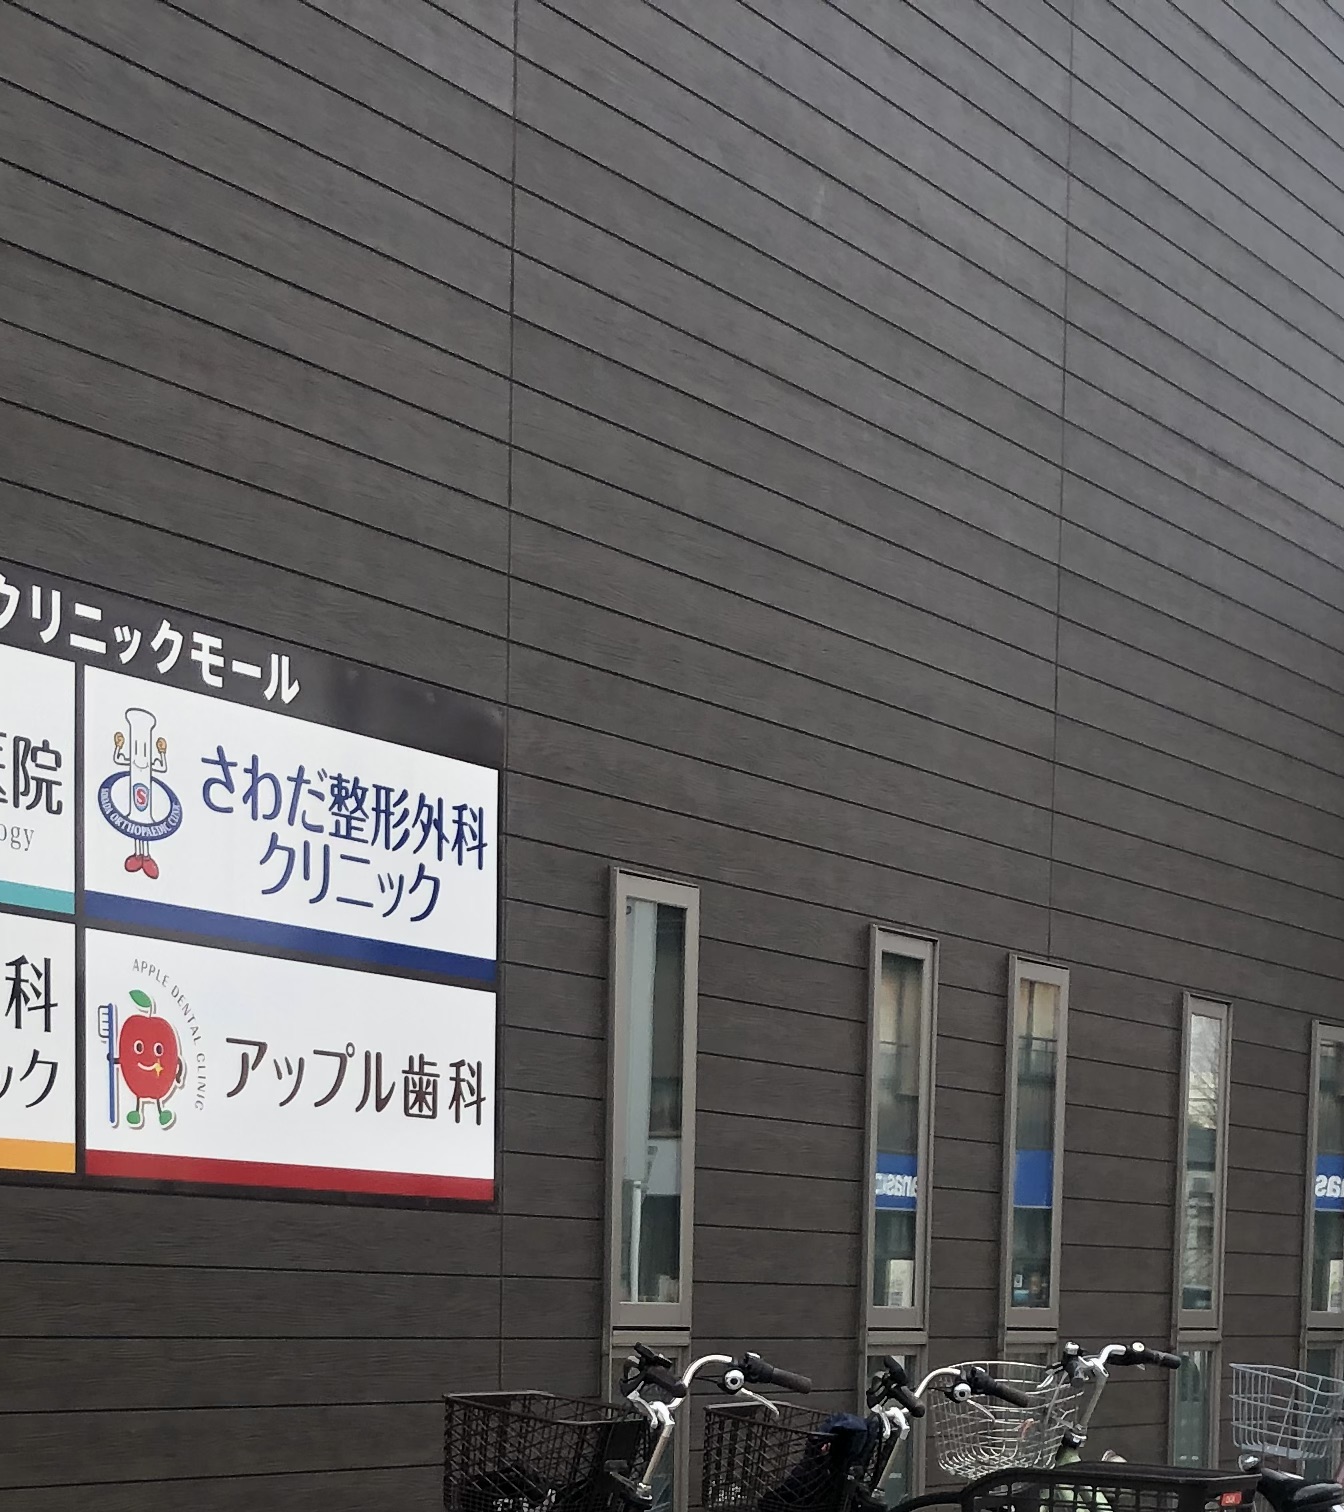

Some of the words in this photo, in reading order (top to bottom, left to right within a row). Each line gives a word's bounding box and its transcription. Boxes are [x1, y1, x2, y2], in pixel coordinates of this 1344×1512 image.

[201, 745, 488, 870] さわだ整形外科
[260, 832, 441, 922] クリニック
[132, 958, 170, 988] APPLE
[170, 985, 202, 1047] DENTAL
[194, 1052, 206, 1111] CLINIC
[225, 1037, 487, 1126] アップル歯科
